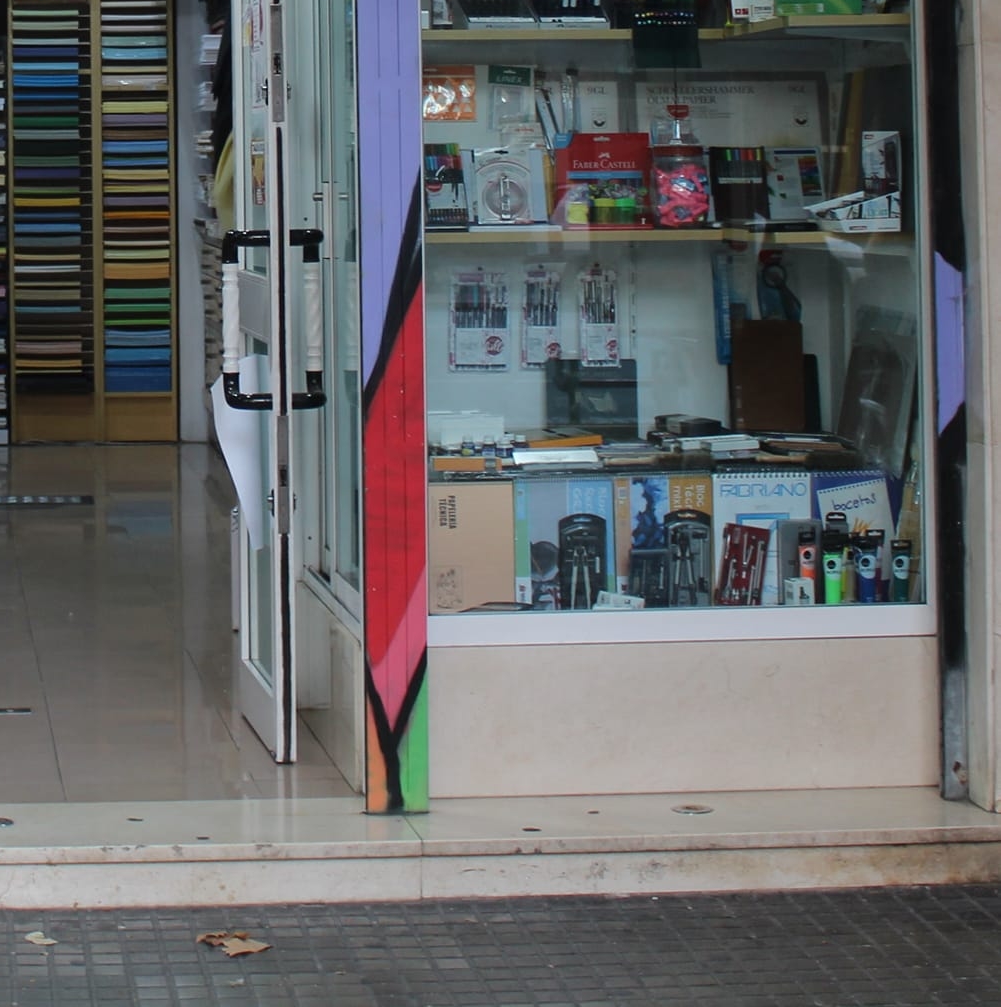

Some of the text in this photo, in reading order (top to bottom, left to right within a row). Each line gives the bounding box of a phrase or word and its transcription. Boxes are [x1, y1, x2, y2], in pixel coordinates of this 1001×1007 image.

[673, 485, 683, 511] mixt
[695, 484, 706, 507] Bloc
[719, 482, 807, 497] FABRIANO
[832, 492, 877, 512] bocetos
